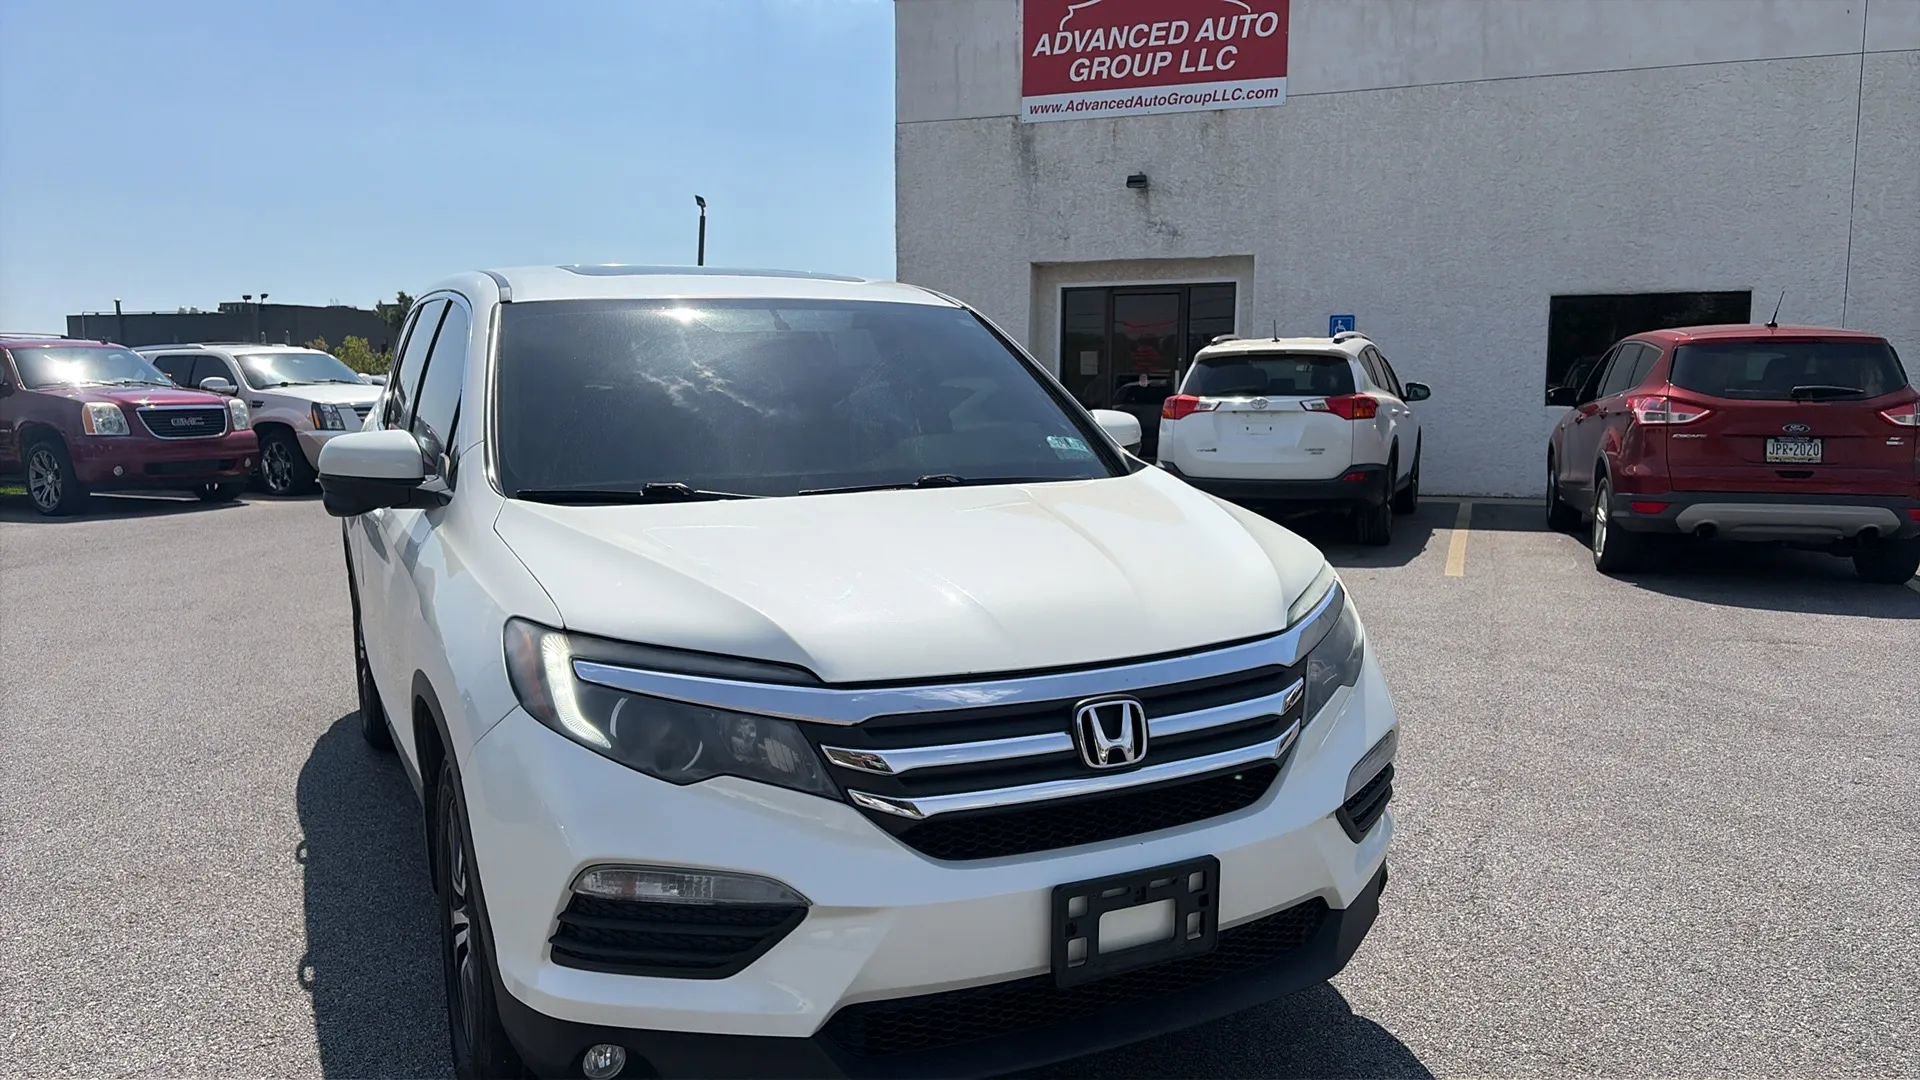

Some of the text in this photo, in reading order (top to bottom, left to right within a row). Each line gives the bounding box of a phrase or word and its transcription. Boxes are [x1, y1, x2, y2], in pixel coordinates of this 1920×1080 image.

[1032, 11, 1279, 57] ADVANCED AUTO
[1069, 45, 1238, 82] GROUP LLC
[1029, 87, 1279, 115] www.AdvancedAutoGroupLLC.com
